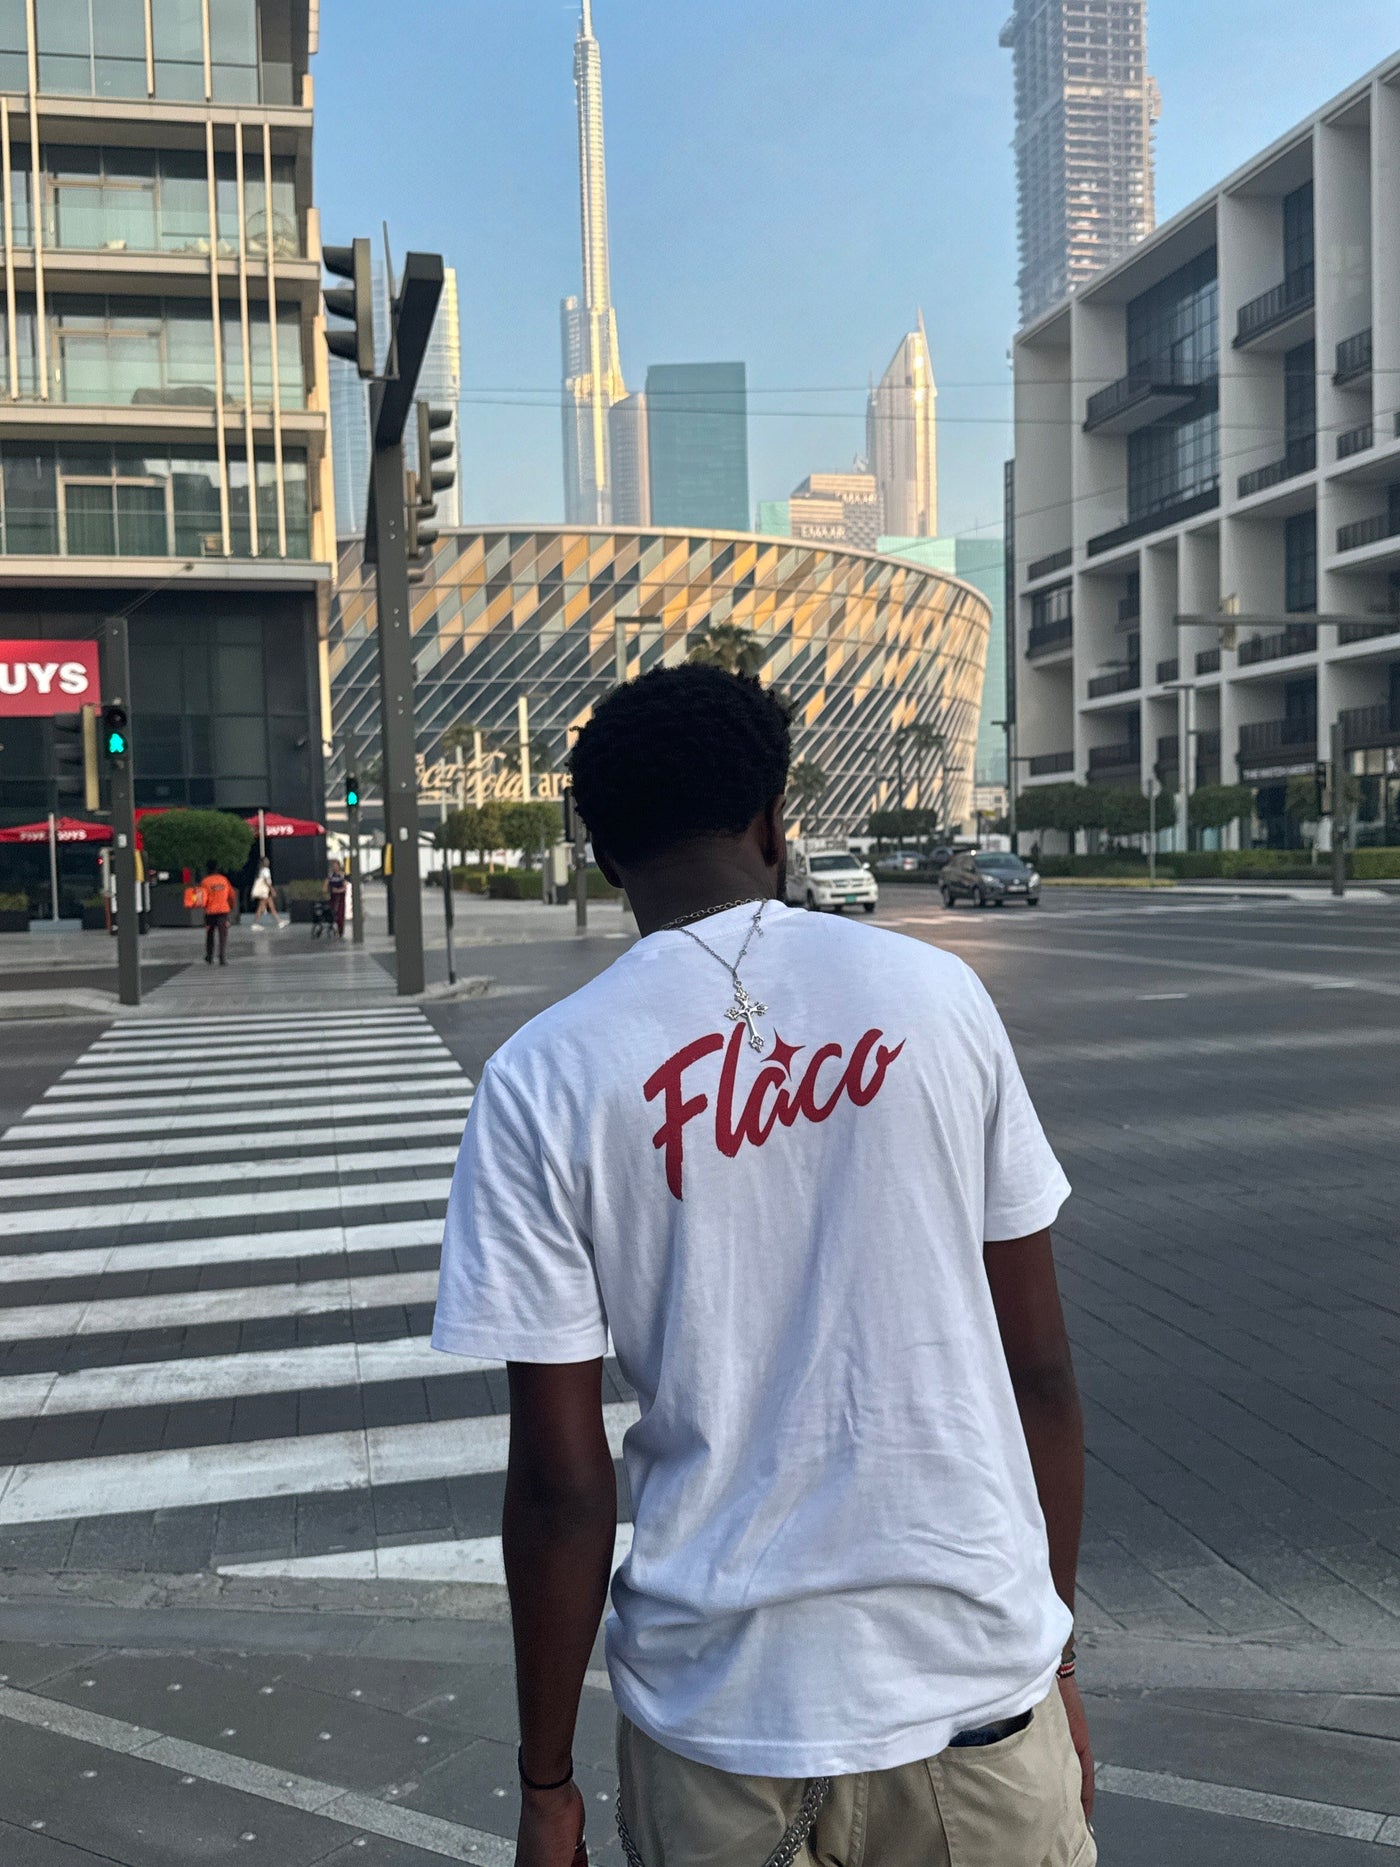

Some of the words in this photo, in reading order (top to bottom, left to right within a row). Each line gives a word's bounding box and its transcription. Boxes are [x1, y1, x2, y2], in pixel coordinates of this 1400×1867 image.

[0, 662, 89, 694] UYS
[57, 829, 87, 840] GUYS
[643, 1021, 906, 1201] Flaco
